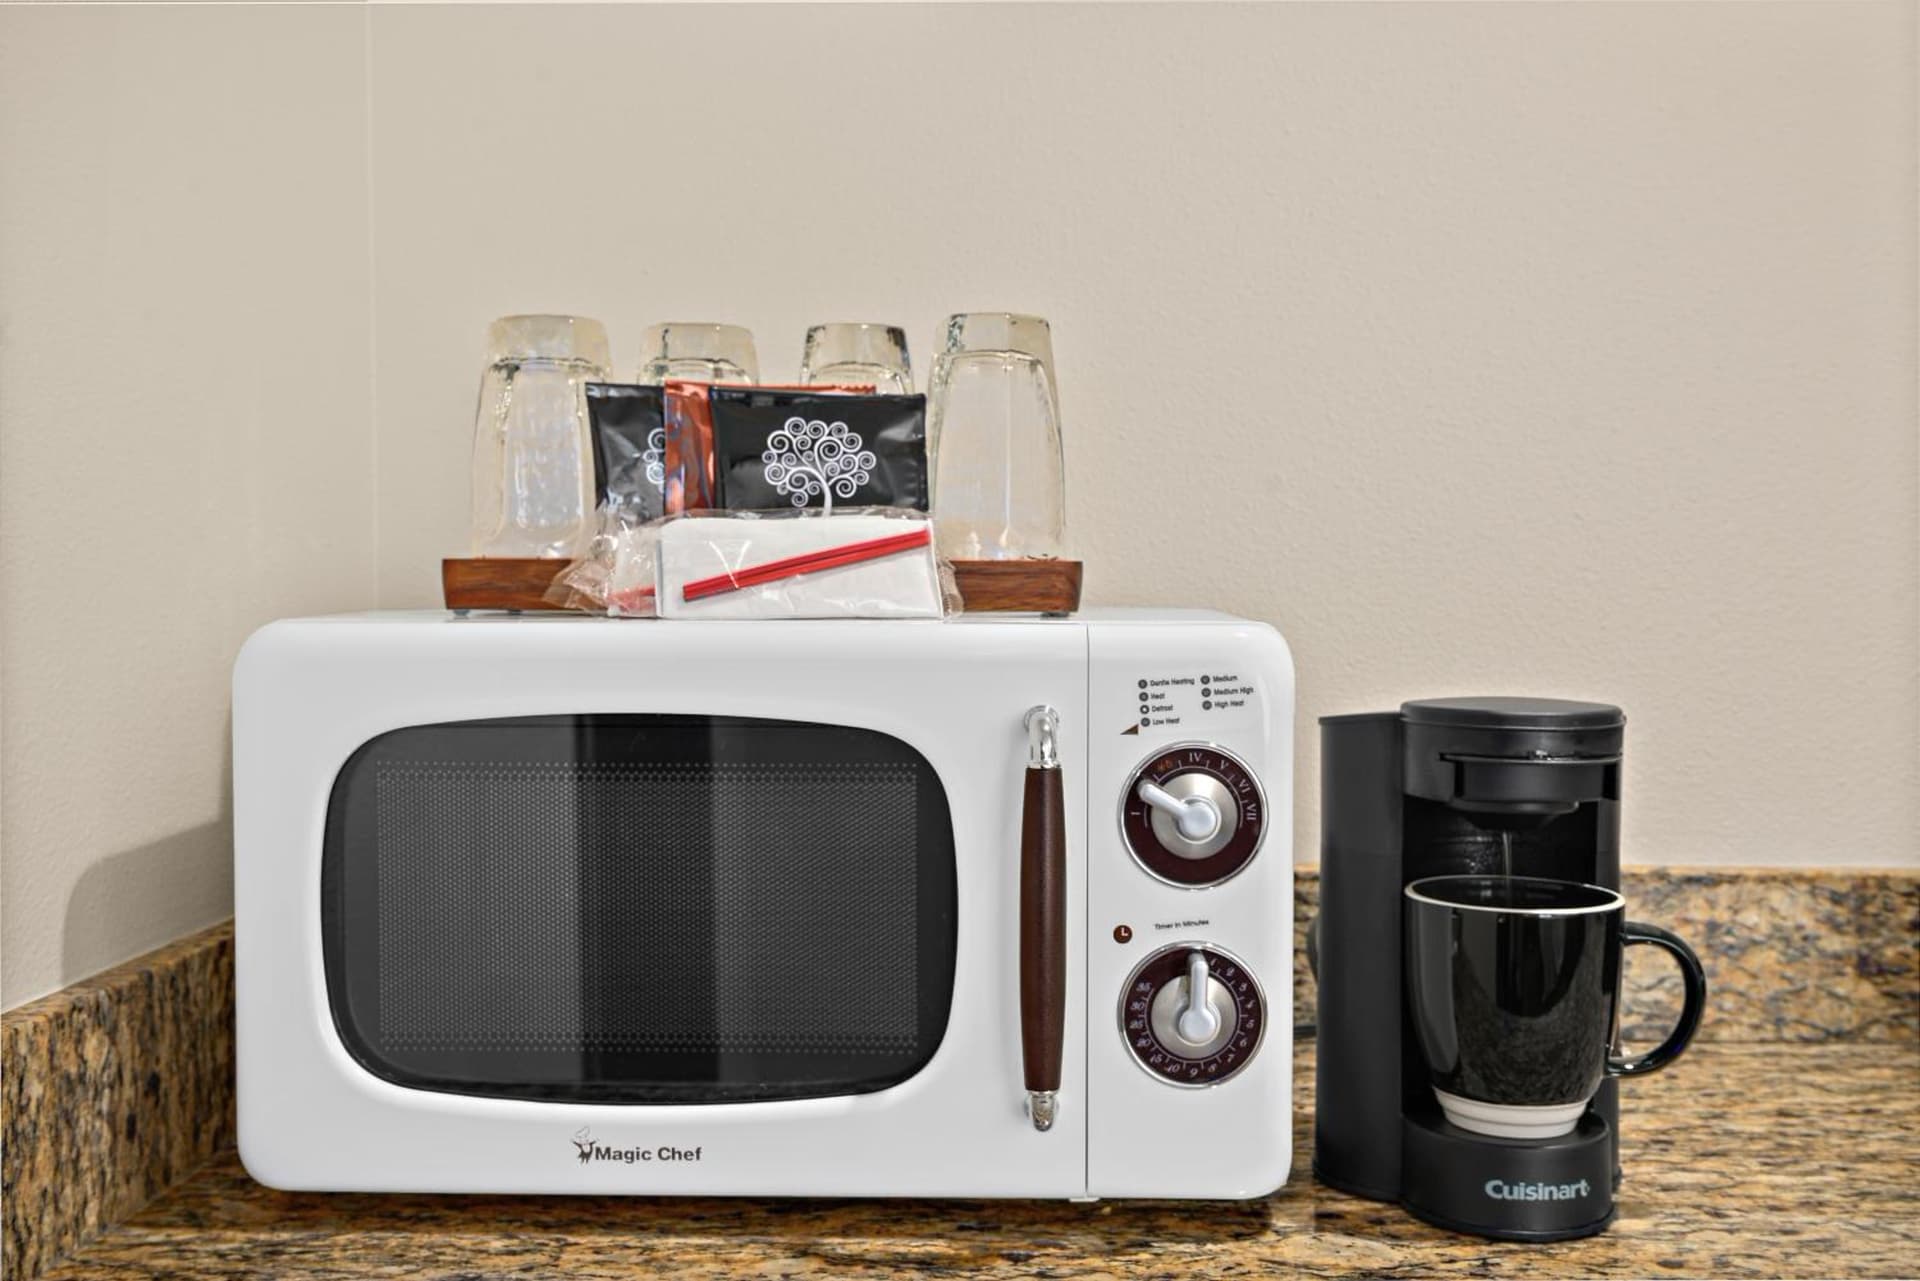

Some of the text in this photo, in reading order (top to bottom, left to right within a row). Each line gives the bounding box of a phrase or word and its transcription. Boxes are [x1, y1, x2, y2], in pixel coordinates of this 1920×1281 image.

[1189, 752, 1203, 763] IV
[1246, 1019, 1255, 1029] 5
[1239, 1038, 1248, 1048] 6
[1189, 1067, 1199, 1077] 9
[595, 1146, 702, 1164] Magic Chef
[1484, 1179, 1588, 1201] Cuisinart
